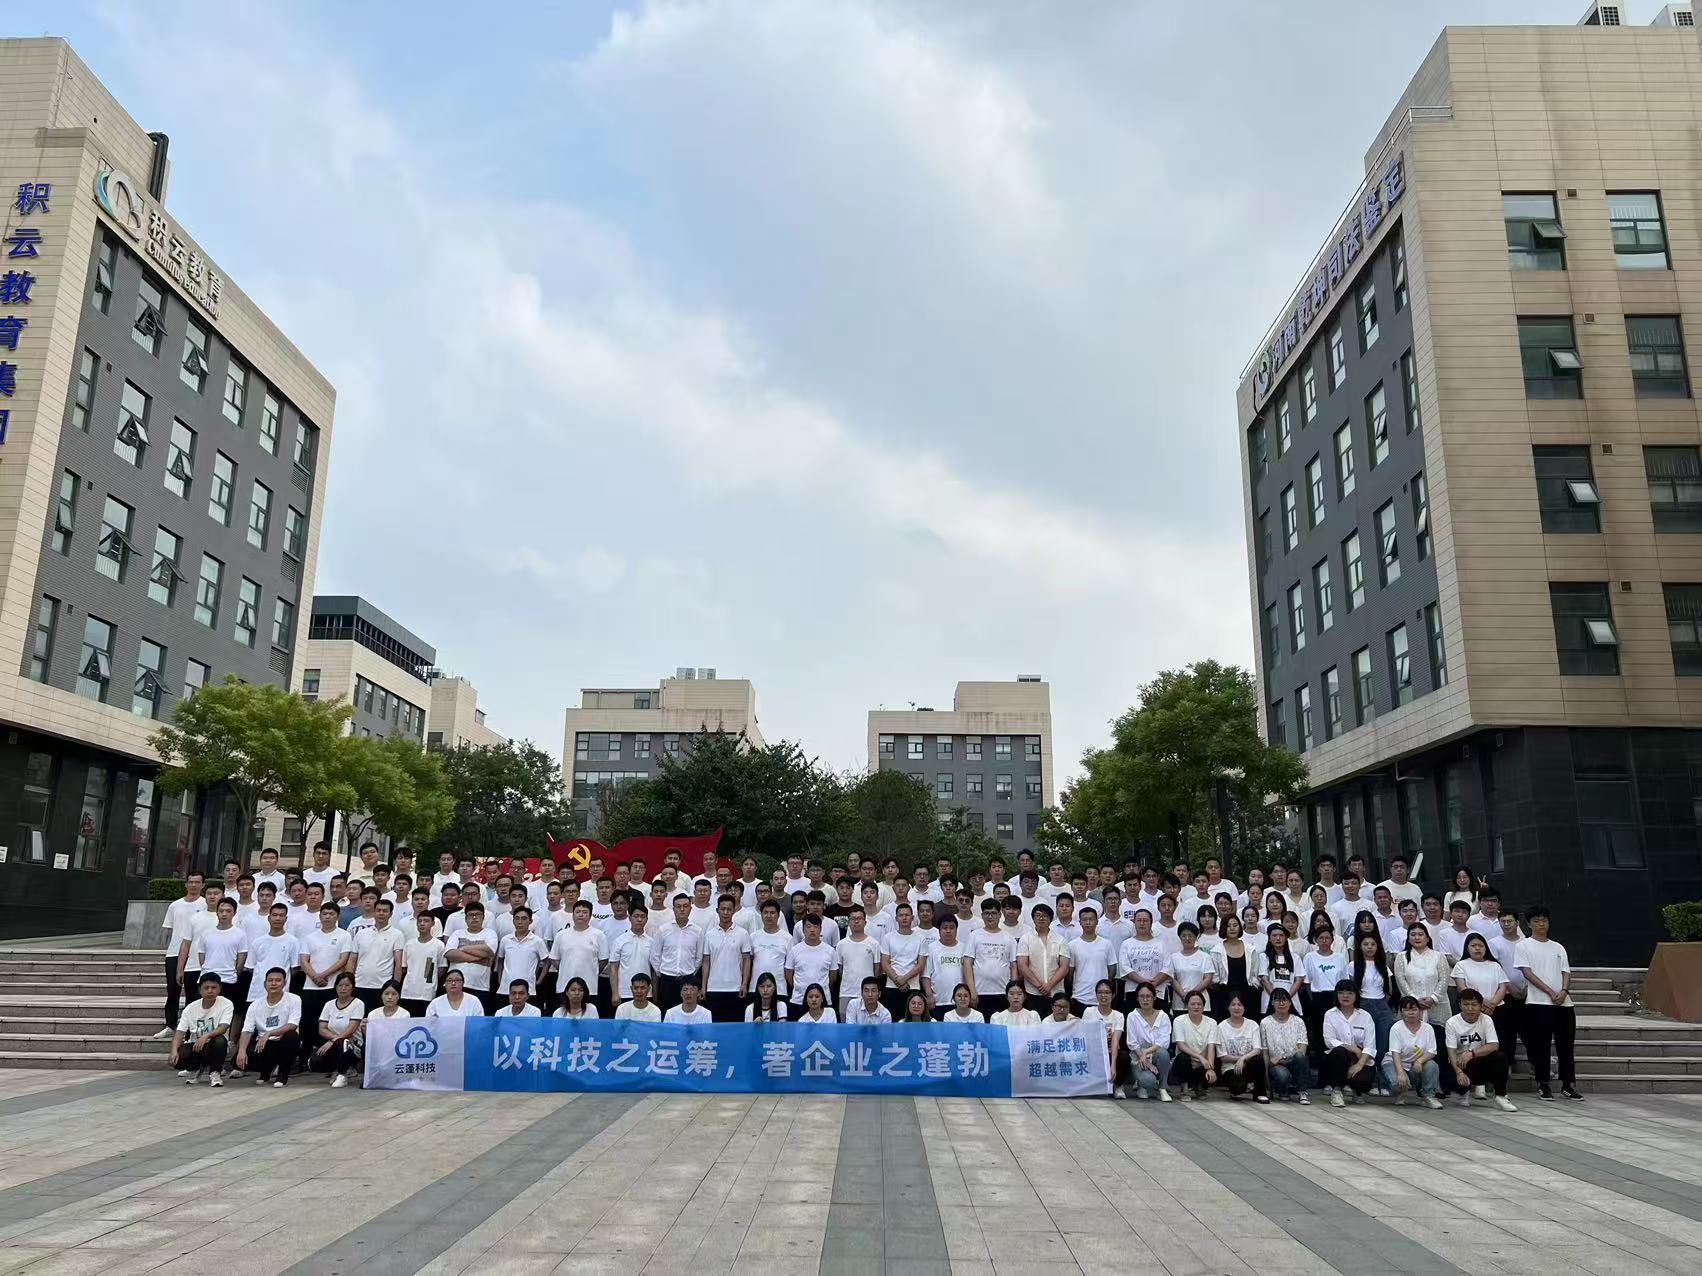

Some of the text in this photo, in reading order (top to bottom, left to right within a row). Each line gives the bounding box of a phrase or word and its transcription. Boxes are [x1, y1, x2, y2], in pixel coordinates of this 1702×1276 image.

[148, 208, 225, 304] 积云教育
[0, 182, 52, 445] 积云教育集
[1026, 1037, 1087, 1054] 满足挑剔
[395, 1063, 436, 1074] 云蓬科技
[1028, 1062, 1090, 1079] 超越需求
